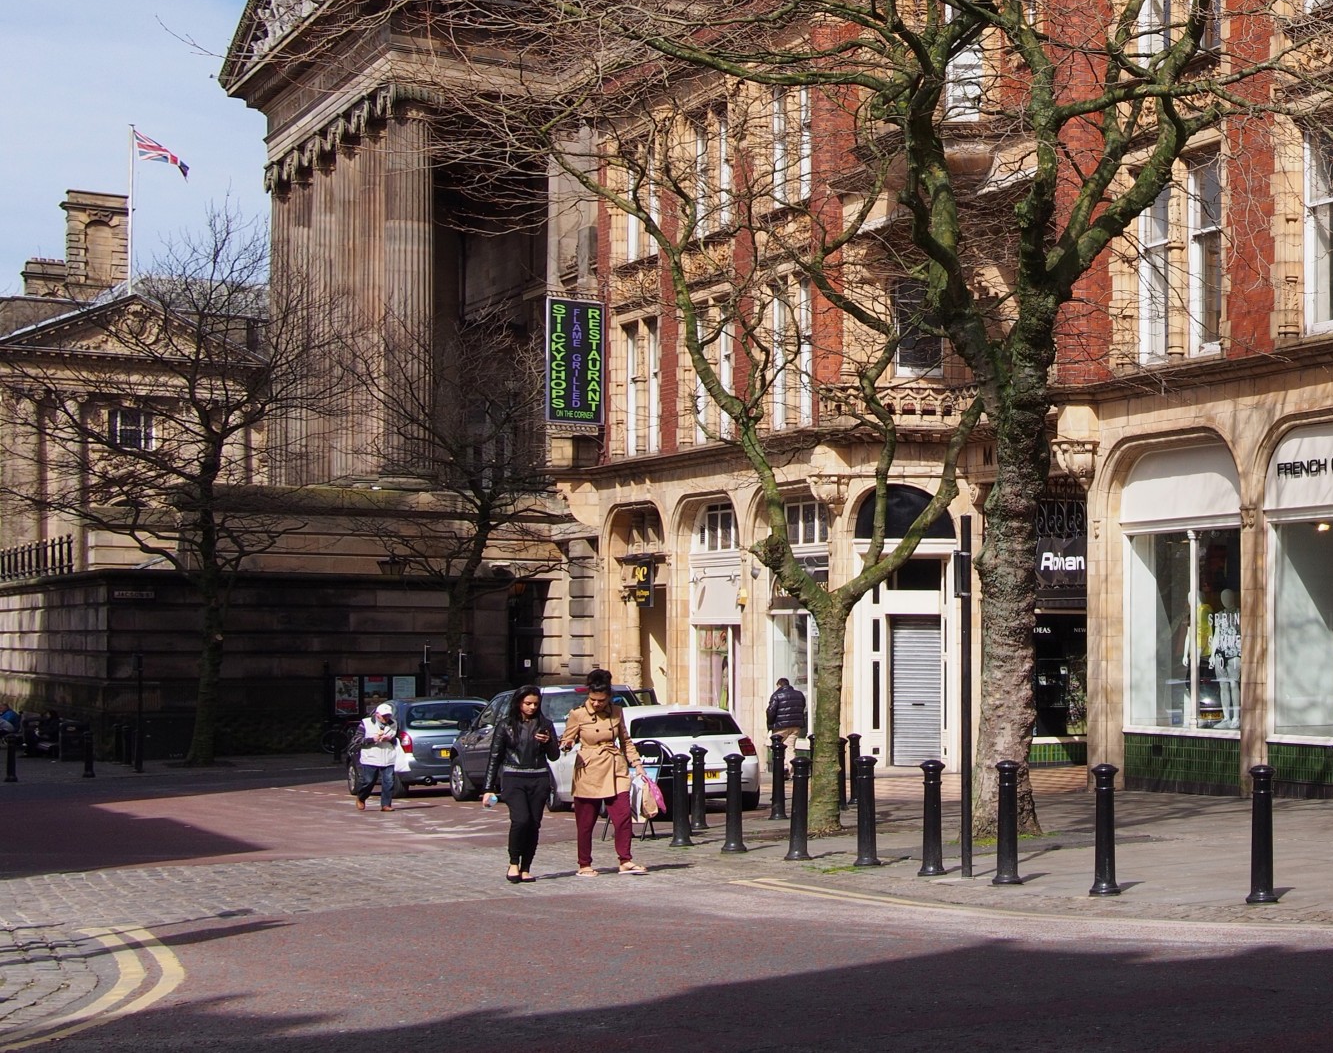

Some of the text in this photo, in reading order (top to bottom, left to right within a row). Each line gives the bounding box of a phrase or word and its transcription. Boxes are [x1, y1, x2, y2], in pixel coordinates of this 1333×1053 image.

[551, 304, 566, 408] STICKYCHOPS
[572, 308, 582, 408] FLAME GRILLED
[587, 308, 600, 411] RESTAURANT
[556, 409, 594, 419] ON THE CORNER
[1277, 458, 1327, 478] FRENCH
[1040, 551, 1085, 571] Rohan
[1208, 613, 1240, 627] SPRIN
[1208, 657, 1237, 669] 201
